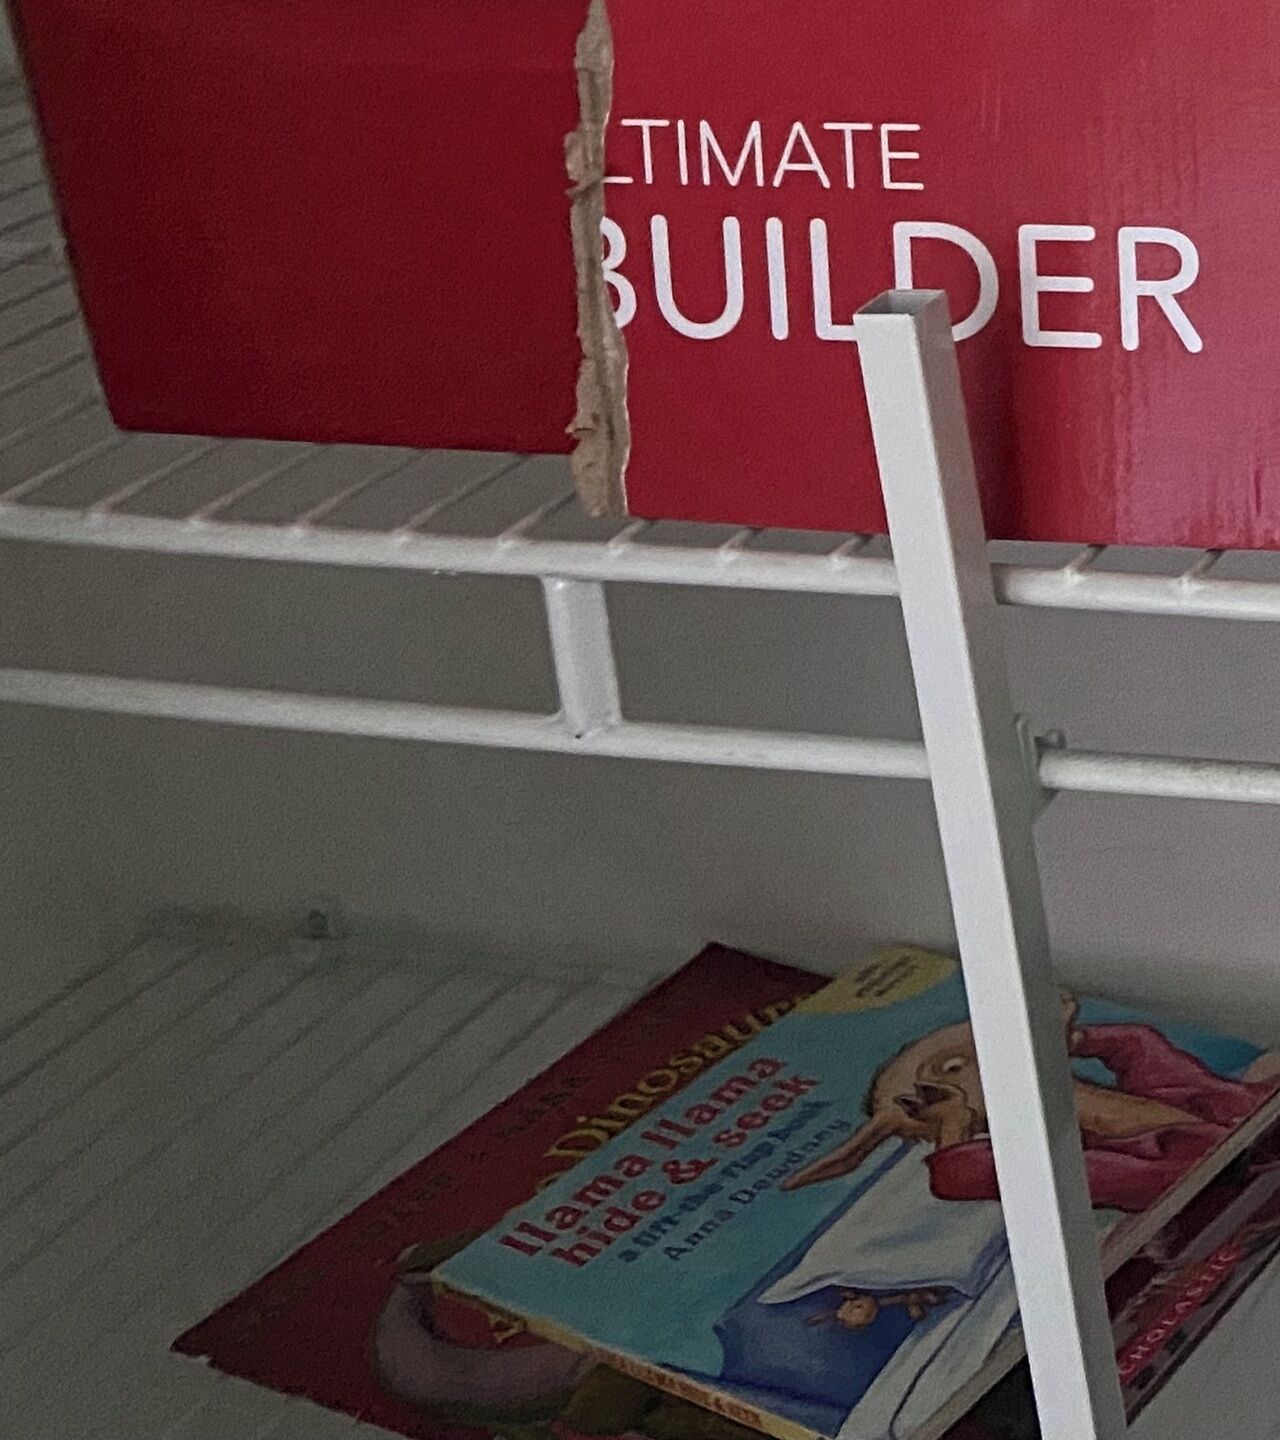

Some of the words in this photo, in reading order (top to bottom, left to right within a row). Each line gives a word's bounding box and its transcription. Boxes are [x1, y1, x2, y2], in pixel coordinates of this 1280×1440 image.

[600, 215, 1202, 353] BUILDER
[498, 1155, 654, 1256] llama
[640, 1057, 786, 1151] llama
[544, 994, 813, 1158] Dinosaur
[549, 1189, 667, 1268] hide
[661, 1158, 720, 1185] &
[711, 1075, 822, 1148] seek
[663, 1208, 737, 1262] Anna
